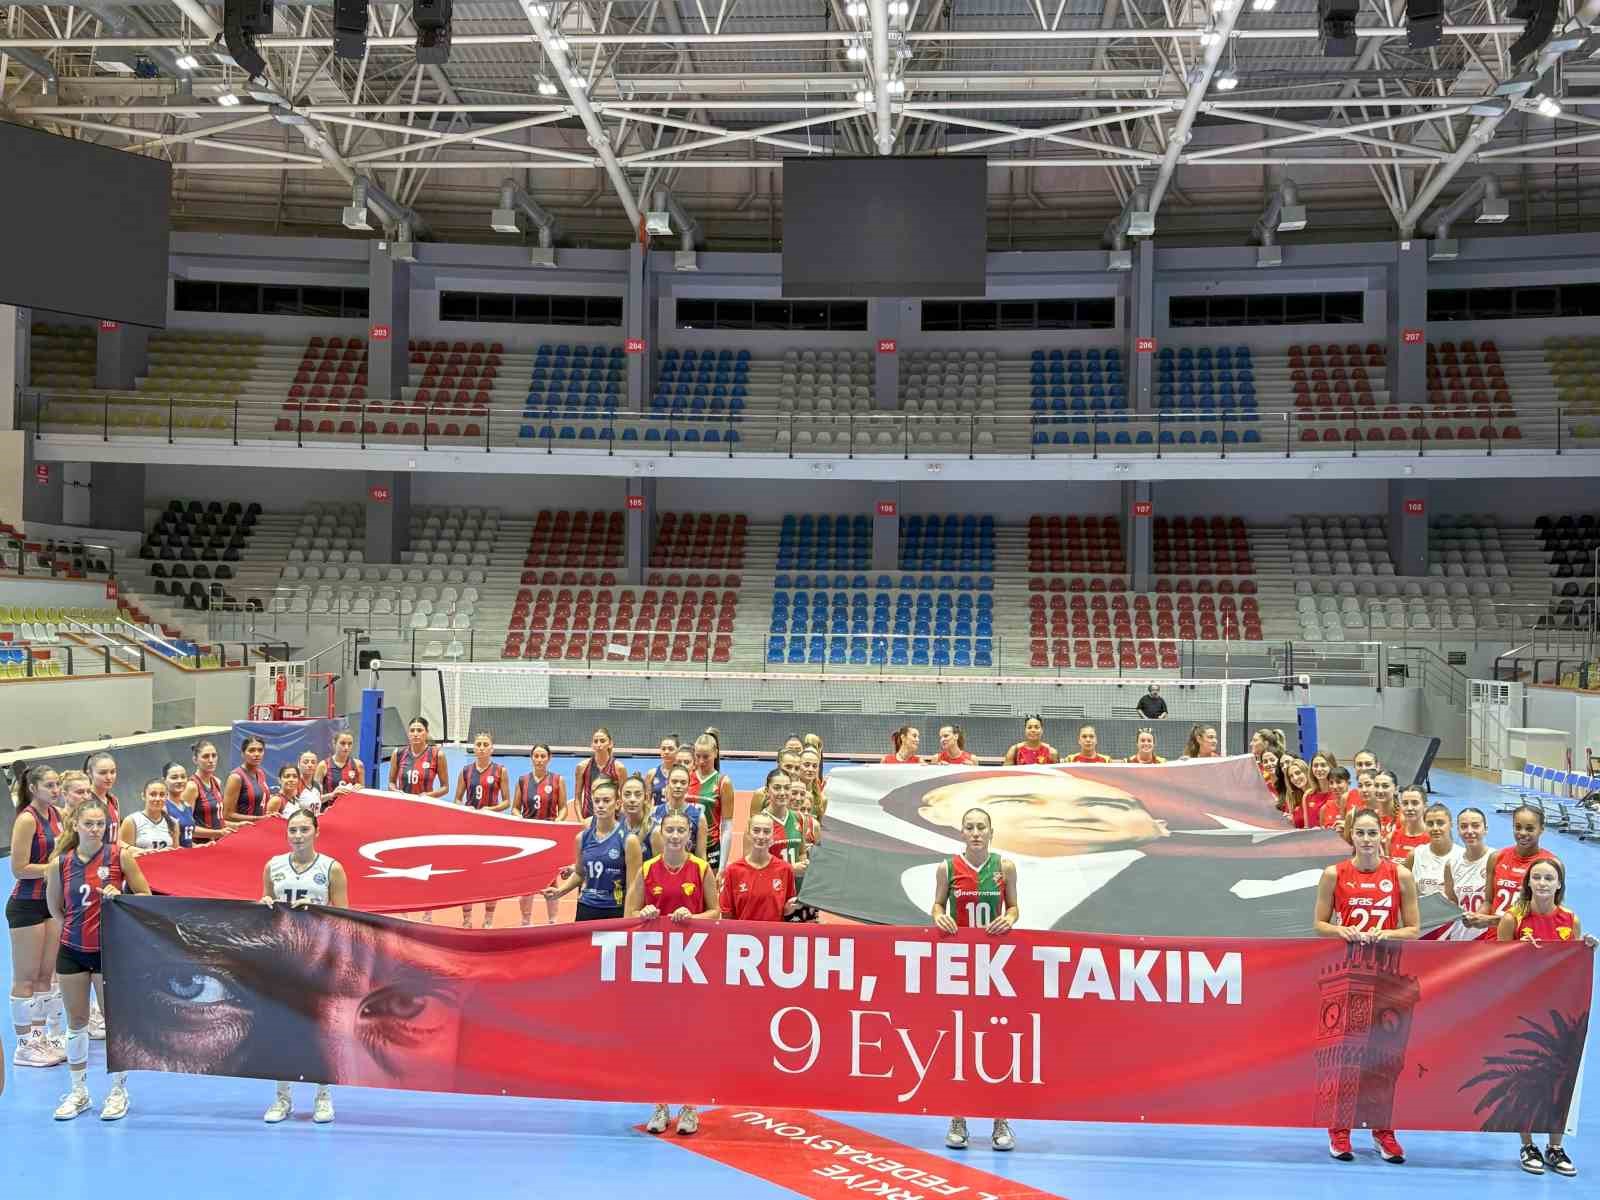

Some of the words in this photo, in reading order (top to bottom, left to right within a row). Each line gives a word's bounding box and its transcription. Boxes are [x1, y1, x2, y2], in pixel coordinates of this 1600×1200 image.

[373, 329, 387, 337] 203
[1405, 333, 1420, 341] 207
[629, 341, 642, 350] 204
[880, 342, 895, 351] 205
[1138, 341, 1153, 350] 206
[629, 498, 642, 507] 105
[1136, 504, 1150, 513] 107
[406, 769, 419, 785] 16
[475, 784, 484, 800] 9
[533, 794, 542, 810] 3
[586, 860, 605, 880] 19
[80, 884, 92, 906] 2
[1348, 897, 1374, 906] aras
[965, 902, 991, 928] 10
[1351, 908, 1390, 933] 27
[592, 931, 709, 984] TEK
[725, 933, 877, 1002] RUH,
[894, 940, 1017, 997] TEK
[1032, 945, 1243, 1004] TAKIM
[770, 1006, 821, 1074] 9
[850, 1009, 1046, 1103] Eylül
[731, 1111, 970, 1195] FEDERASYONU
